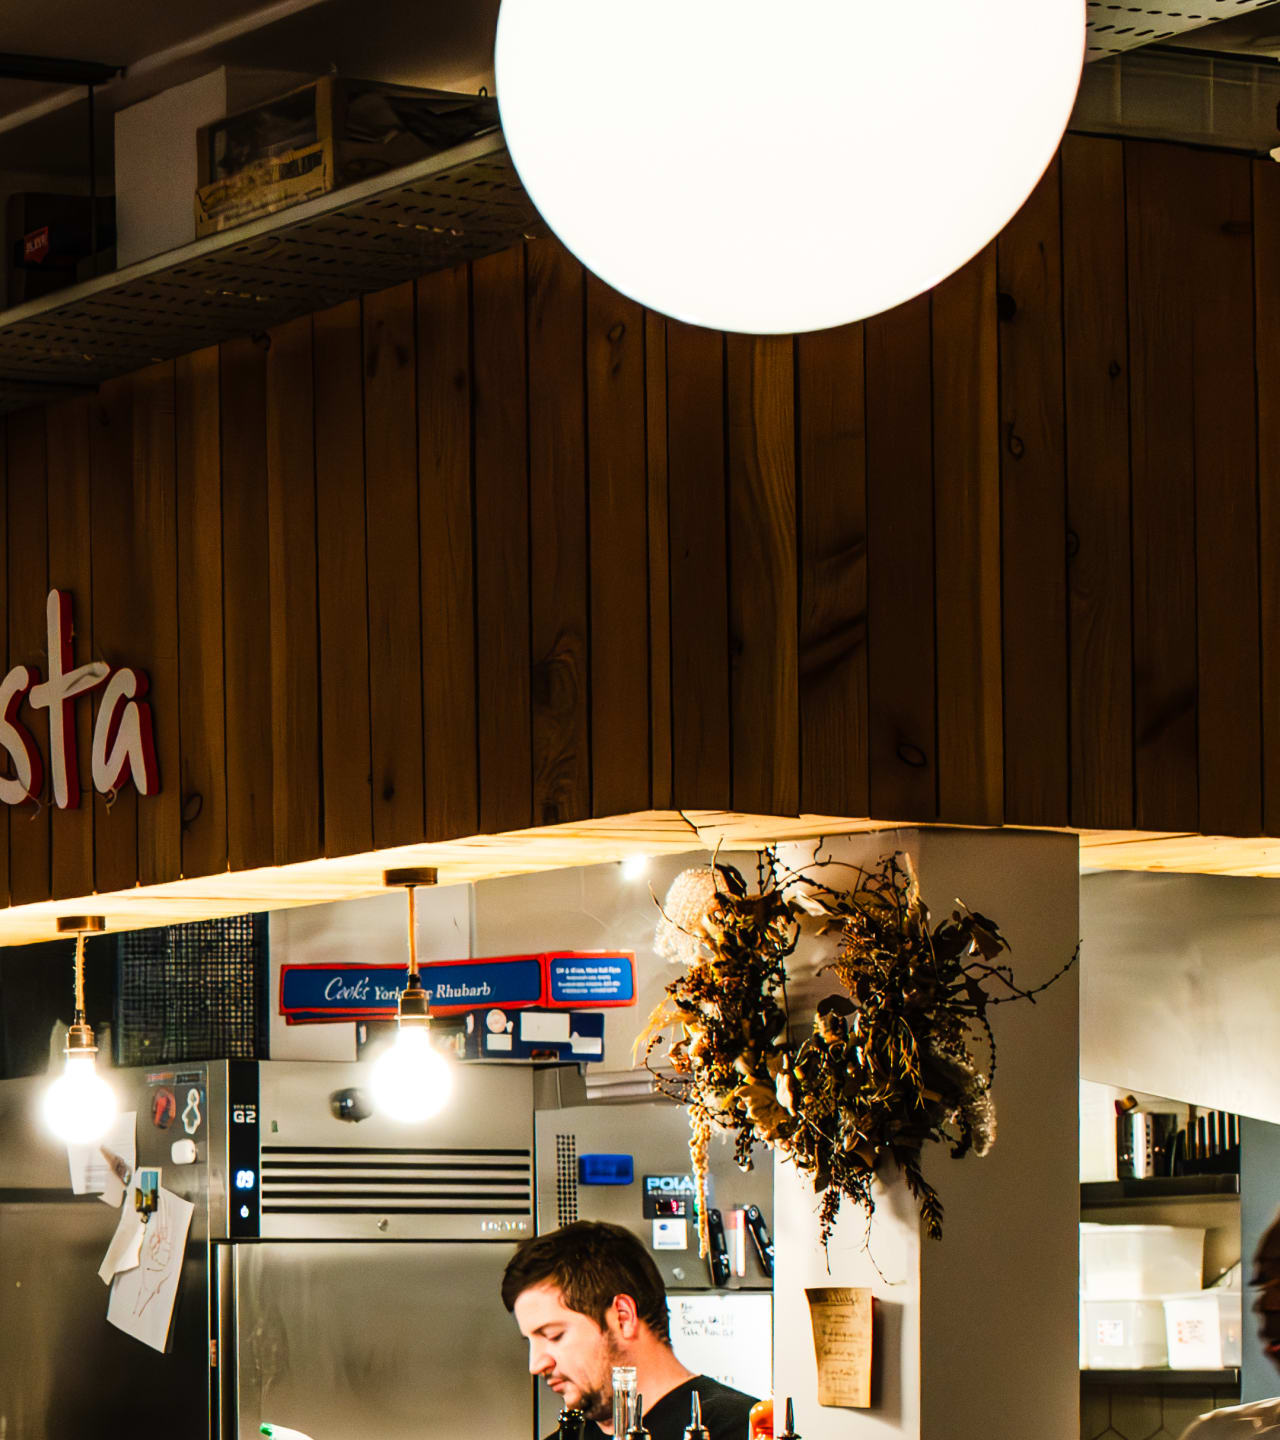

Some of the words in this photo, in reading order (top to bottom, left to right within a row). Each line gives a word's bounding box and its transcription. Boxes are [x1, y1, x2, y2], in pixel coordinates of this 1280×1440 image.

[324, 977, 370, 1001] Cook's
[436, 981, 492, 999] Rhubarb
[233, 1109, 257, 1123] G2
